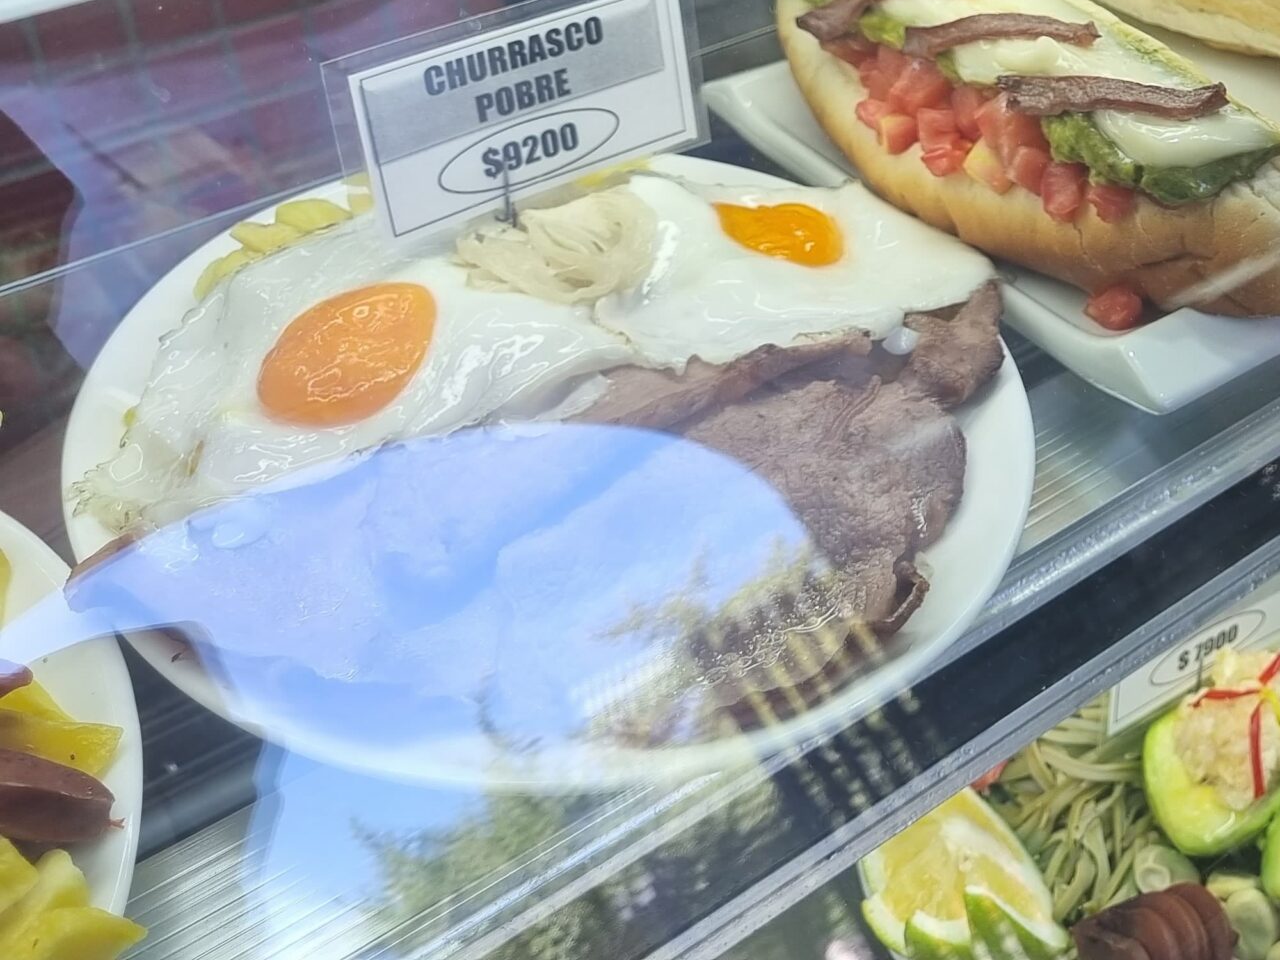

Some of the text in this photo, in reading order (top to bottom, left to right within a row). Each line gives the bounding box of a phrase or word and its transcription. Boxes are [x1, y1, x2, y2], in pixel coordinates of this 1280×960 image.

[423, 16, 604, 96] CHURRASCO
[475, 68, 572, 123] POBRE
[481, 122, 579, 179] $9200
